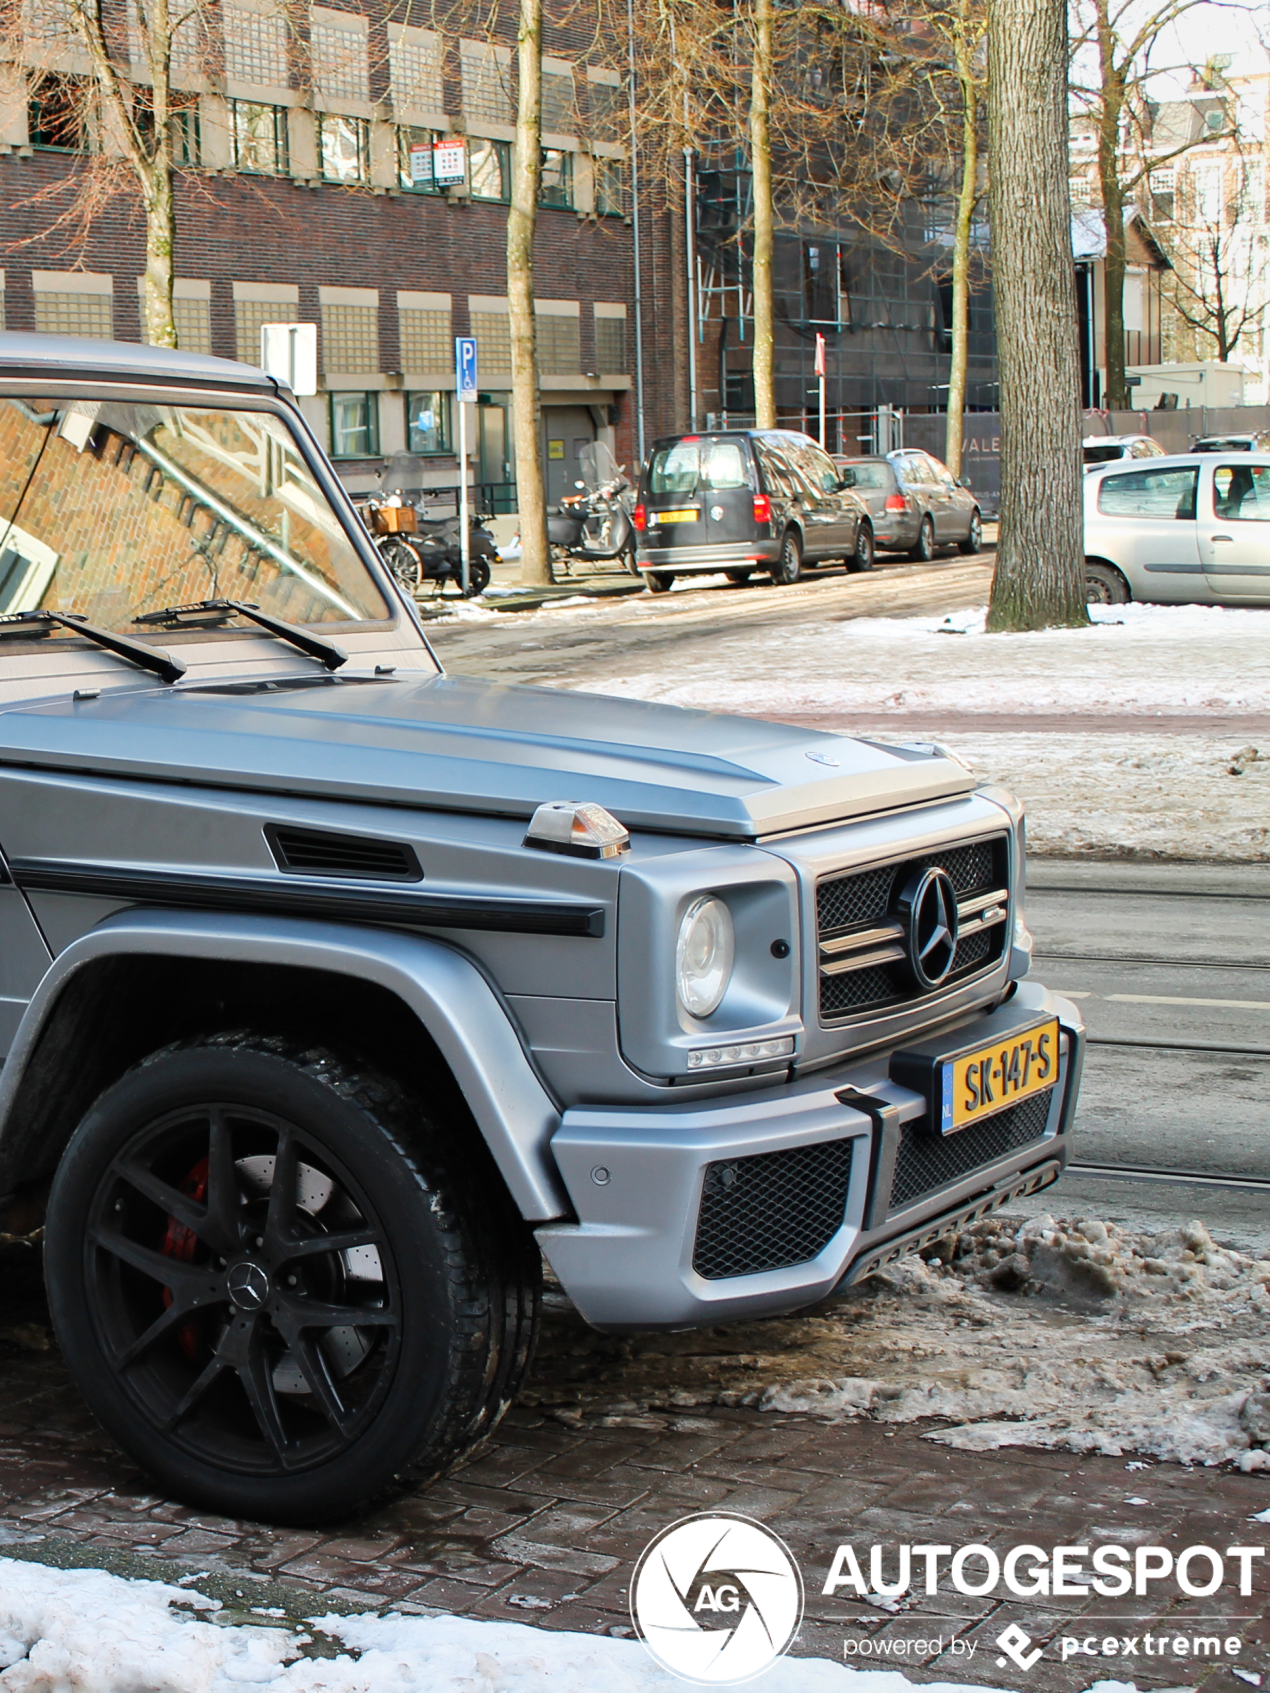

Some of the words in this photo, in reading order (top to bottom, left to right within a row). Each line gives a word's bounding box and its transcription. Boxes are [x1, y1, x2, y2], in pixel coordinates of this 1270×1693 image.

[462, 342, 473, 370] P
[965, 1034, 1050, 1111] SK-147-S
[942, 1103, 951, 1119] NL
